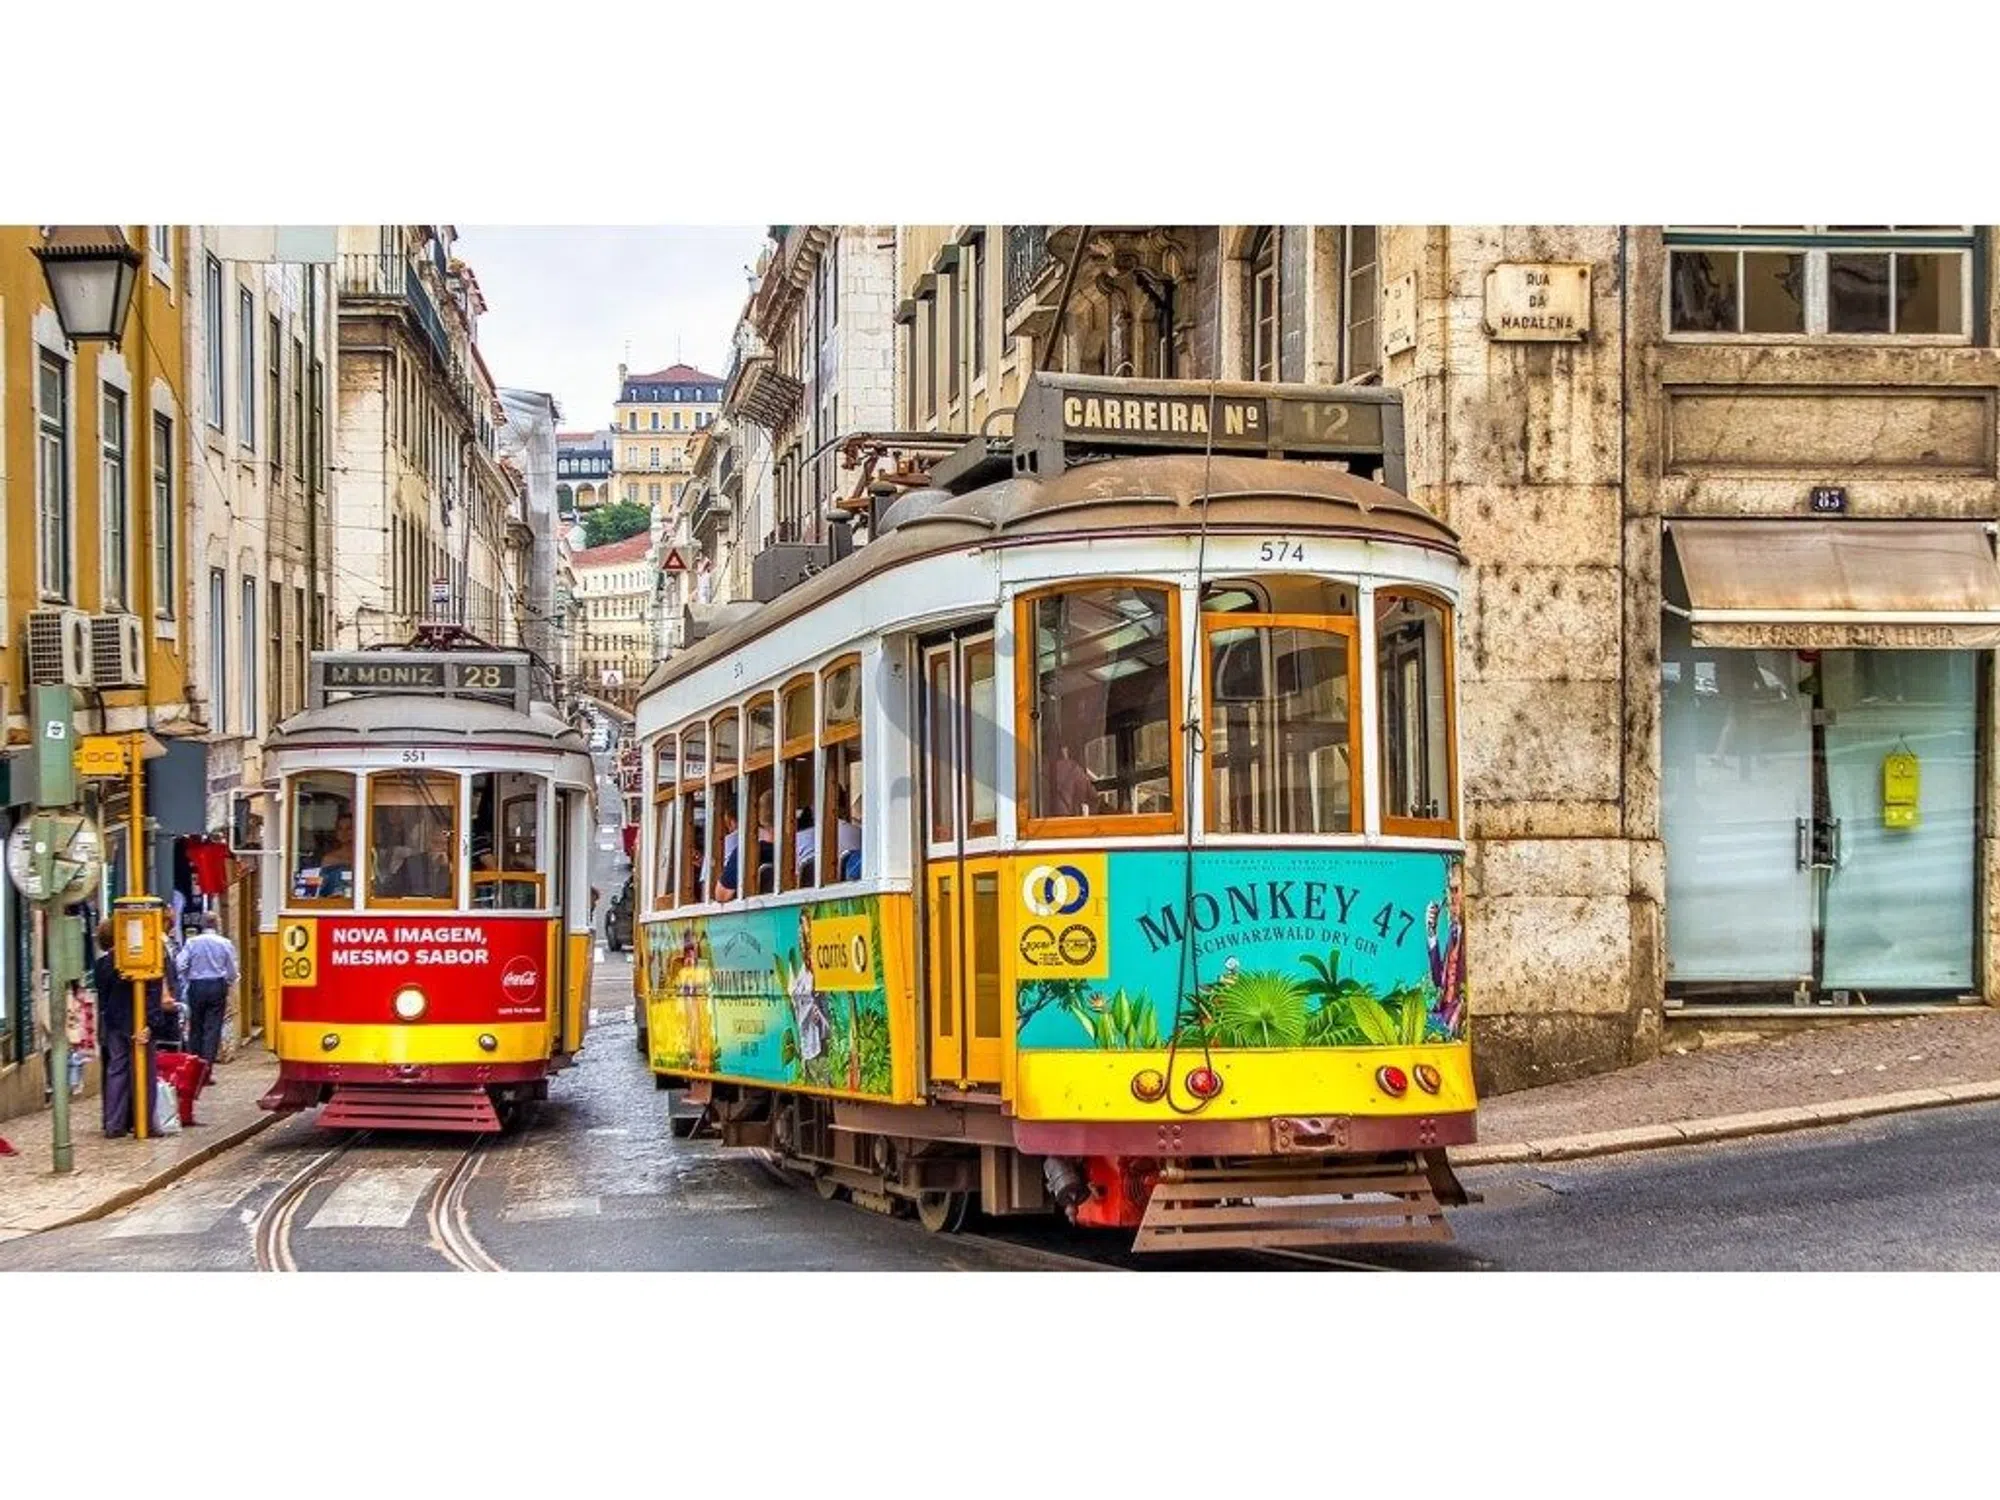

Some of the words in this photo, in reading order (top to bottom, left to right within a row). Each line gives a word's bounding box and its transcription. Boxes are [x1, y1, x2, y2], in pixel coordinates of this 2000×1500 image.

[1526, 273, 1550, 286] RUA
[1529, 295, 1546, 308] DA
[1063, 396, 1208, 433] CARREIRA
[1301, 403, 1349, 441] 12
[1261, 541, 1304, 561] 574
[357, 667, 434, 684] MONIZ
[464, 666, 501, 687] 28
[402, 750, 426, 763] 551
[1136, 881, 1361, 953] MONKEY
[1373, 901, 1416, 949] 47
[332, 928, 389, 944] NOVA
[394, 927, 488, 945] IMAGEM,
[1192, 926, 1317, 957] SCHWARZWALD
[1321, 927, 1350, 945] DRY
[1355, 935, 1379, 957] GIN
[332, 950, 409, 967] MESMO
[414, 948, 489, 965] SABOR
